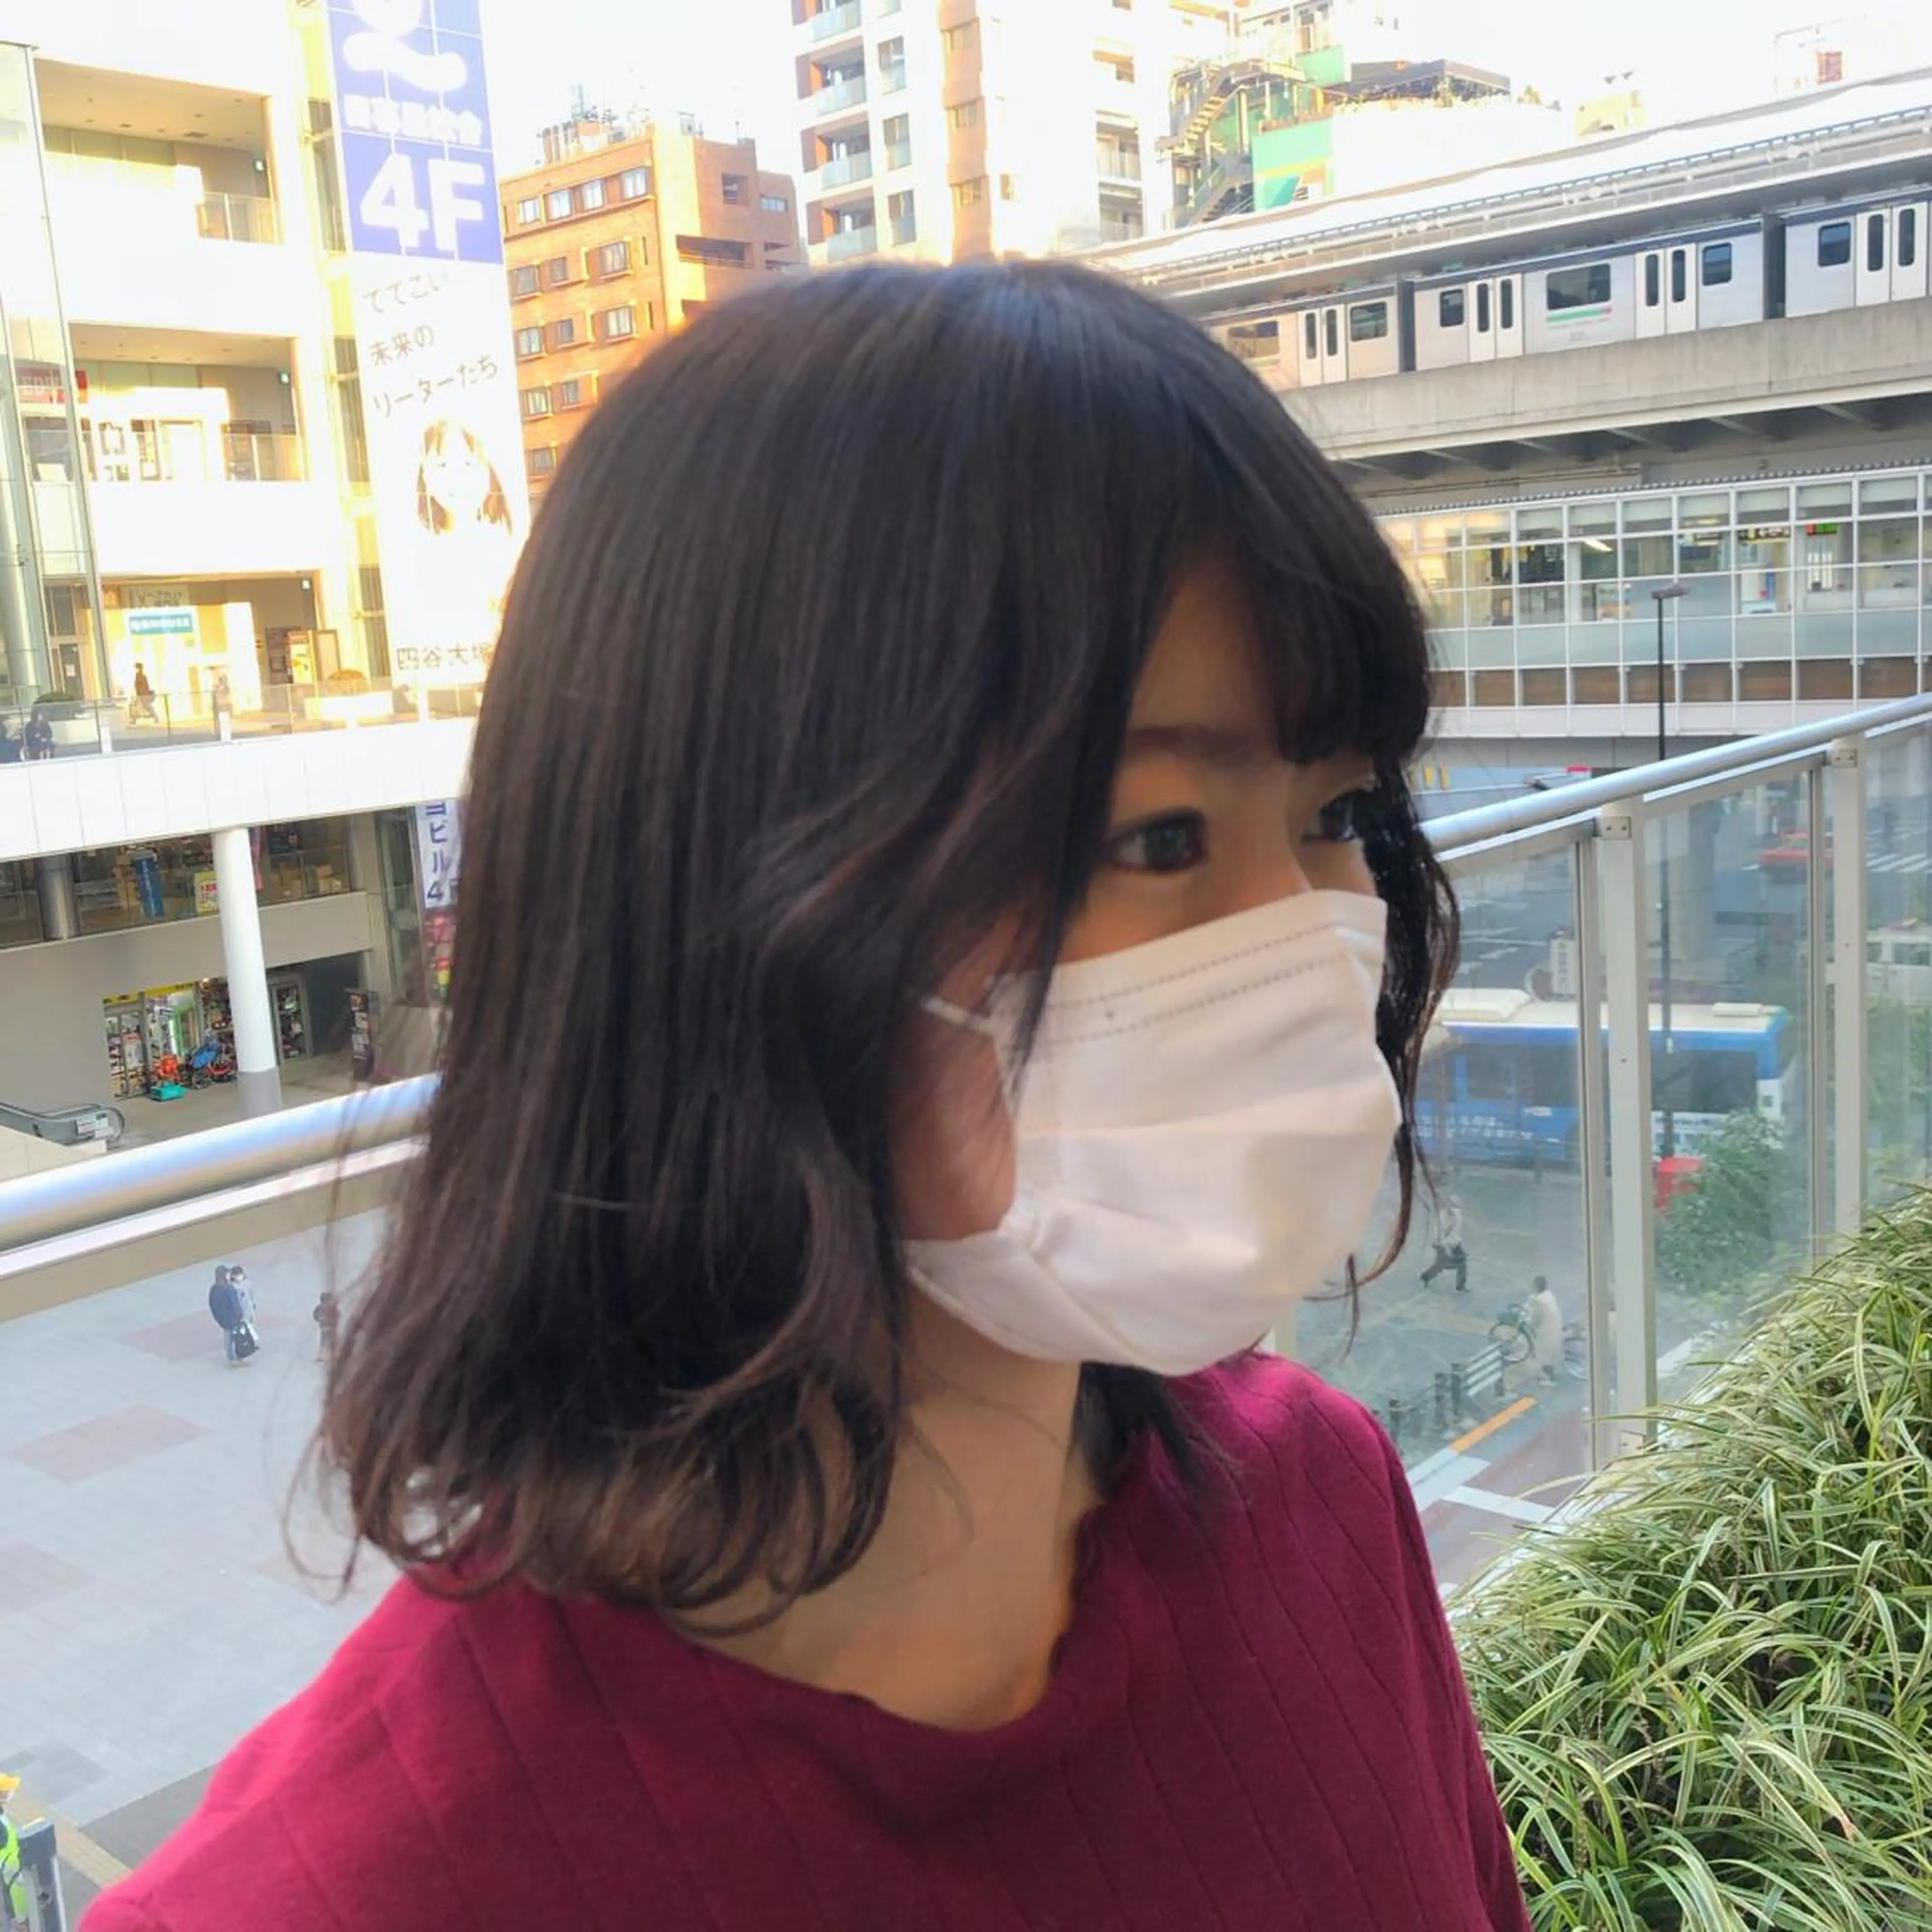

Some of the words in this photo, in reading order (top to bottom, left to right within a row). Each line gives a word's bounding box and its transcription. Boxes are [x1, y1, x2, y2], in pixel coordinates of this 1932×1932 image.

[360, 153, 485, 251] 4F
[369, 324, 435, 366] 未来の
